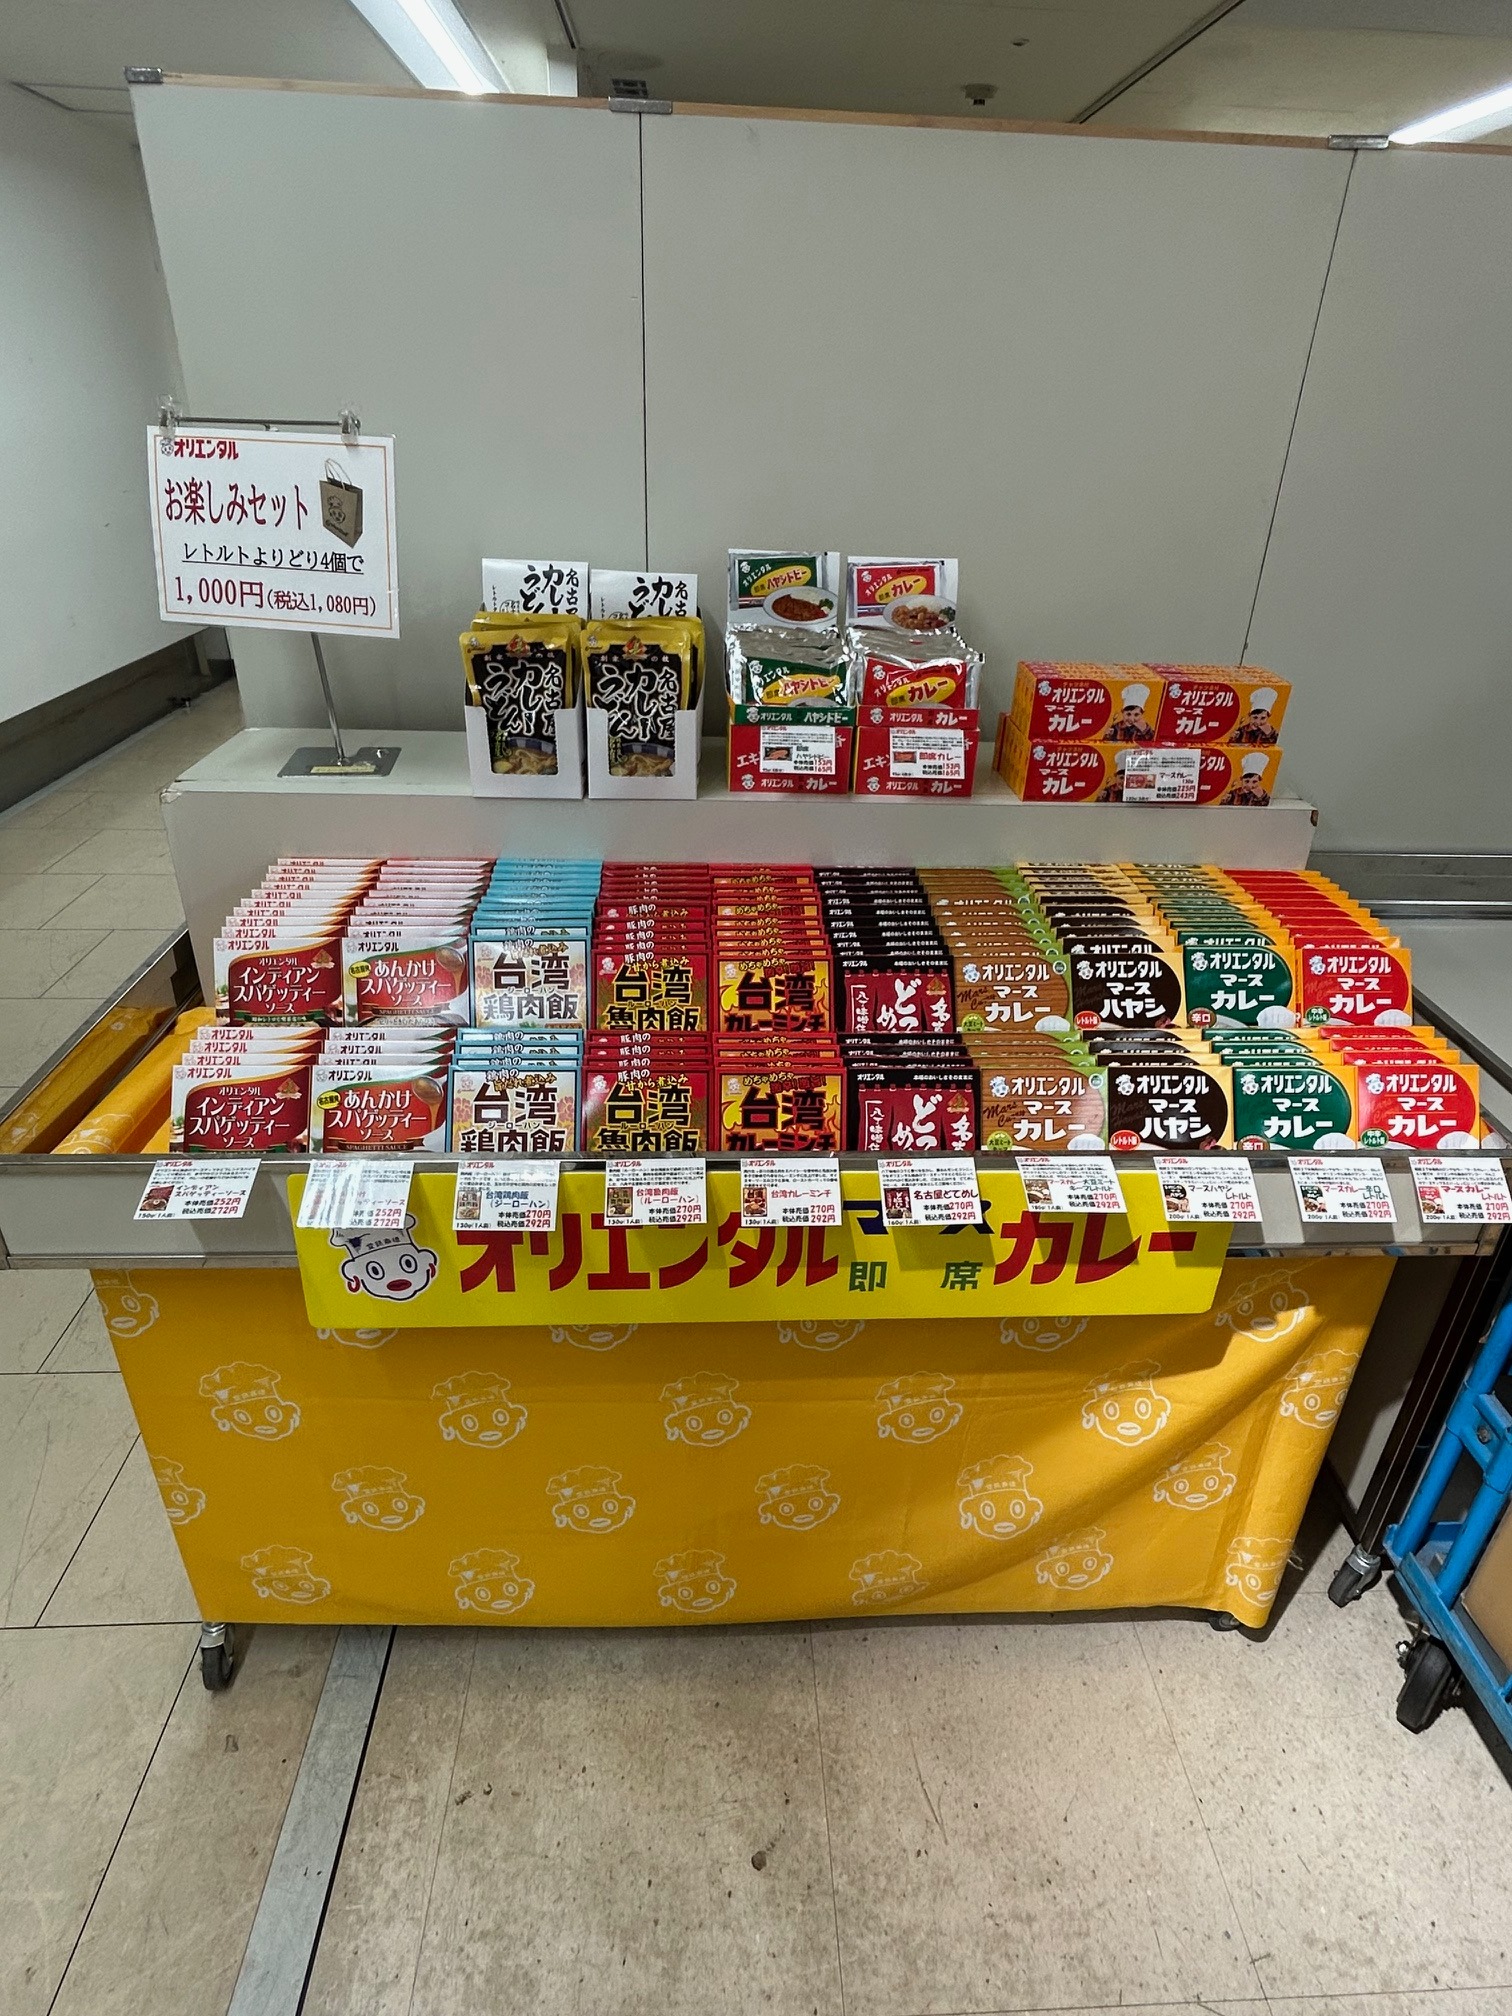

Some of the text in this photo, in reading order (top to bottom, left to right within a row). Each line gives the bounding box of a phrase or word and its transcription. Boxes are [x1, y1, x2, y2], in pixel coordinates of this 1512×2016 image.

[174, 439, 239, 459] オリエンタル
[165, 477, 308, 529] お楽しみセット
[184, 543, 364, 572] レトルトよりどり4個で
[891, 579, 920, 597] カレー
[542, 662, 563, 736] 名古屋
[908, 681, 947, 702] カレー
[1051, 688, 1105, 703] オリエンタル
[1181, 691, 1233, 707] オリエンタル
[658, 667, 679, 740] 名古屋
[761, 712, 848, 722] オリエンタル ハヤシドビー
[890, 712, 967, 725] オリエンタル カレー
[1048, 714, 1092, 732] カレー
[1176, 717, 1219, 735] カレー
[1046, 753, 1098, 767] オリエンタル
[806, 778, 837, 790] カレー
[931, 781, 962, 793] カレー
[1042, 778, 1085, 795] カレー
[628, 904, 656, 915] 豚肉の
[235, 929, 276, 938] オリエンタル
[228, 940, 269, 950] オリエンタル
[358, 942, 399, 952] オリエンタル
[259, 957, 298, 966] オリエンタル
[624, 952, 654, 963] 豚肉の
[739, 957, 785, 971] めちゃめちゃ
[1210, 953, 1275, 970] オリエンタル
[1327, 956, 1391, 973] オリエンタル
[239, 966, 320, 984] インディアン
[375, 960, 436, 977] あんかけ
[493, 952, 570, 990] 台湾
[982, 964, 1050, 981] オリエンタル
[1095, 961, 1162, 978] オリエンタル
[361, 977, 451, 995] スパゲッティー
[612, 962, 693, 1005] 台湾
[1106, 982, 1152, 995] マース
[1220, 974, 1263, 987] マース
[1337, 978, 1380, 990] マース
[233, 984, 326, 1002] スパゲッティー
[736, 971, 815, 1011] 台湾
[957, 987, 988, 1002] Mars
[993, 986, 1038, 998] マース
[266, 1003, 294, 1013] ソース
[391, 995, 422, 1006] ソース
[483, 993, 578, 1020] 鶏肉飯
[1210, 990, 1275, 1010] カレー
[1329, 994, 1391, 1014] カレー
[985, 1002, 1050, 1022] カレー
[1099, 998, 1166, 1019] ハヤシ
[1192, 1013, 1211, 1023] 辛口
[211, 1030, 253, 1040] オリエンタル
[187, 1068, 232, 1078] オリエンタル
[329, 1070, 372, 1080] オリエンタル
[618, 1069, 650, 1082] 豚肉の
[743, 1072, 794, 1086] めちゃめちゃ
[219, 1087, 261, 1095] オリエンタル
[1011, 1077, 1085, 1096] オリエンタル
[1137, 1075, 1209, 1094] オリエンタル
[1261, 1075, 1332, 1094] オリエンタル
[1386, 1074, 1457, 1093] オリエンタル
[196, 1097, 285, 1116] インディアン
[344, 1090, 412, 1109] あんかけ
[473, 1082, 558, 1125] 台湾
[604, 1081, 691, 1128] 台湾
[740, 1085, 826, 1129] 台湾
[1023, 1101, 1072, 1114] マース
[1148, 1099, 1197, 1113] マース
[1272, 1098, 1320, 1112] マース
[1397, 1097, 1444, 1111] マース
[328, 1109, 427, 1128] スパゲッティー
[983, 1102, 1017, 1119] Mars
[189, 1116, 290, 1135] スパゲッティー
[1013, 1119, 1085, 1141] カレー
[1139, 1117, 1212, 1139] ハヤシ
[1264, 1115, 1333, 1138] カレー
[1388, 1115, 1457, 1137] カレー
[223, 1137, 254, 1148] ソース
[360, 1129, 393, 1141] ソース
[771, 1190, 831, 1198] 台湾カレーミンチ
[914, 1190, 978, 1200] 名古屋どてめし
[1323, 1185, 1381, 1193] マースカレー辛口
[1441, 1185, 1490, 1193] マースカレー
[498, 1210, 551, 1218] 本体売価270円
[649, 1205, 701, 1214] 本体売価270円
[924, 1202, 973, 1211] 本体売価270円
[497, 1220, 550, 1228] 税込売価292円
[649, 1214, 701, 1222] 税込売価292円
[925, 1212, 976, 1220] 税込売価292円
[456, 1200, 1197, 1293] オリエンタル マス カレー
